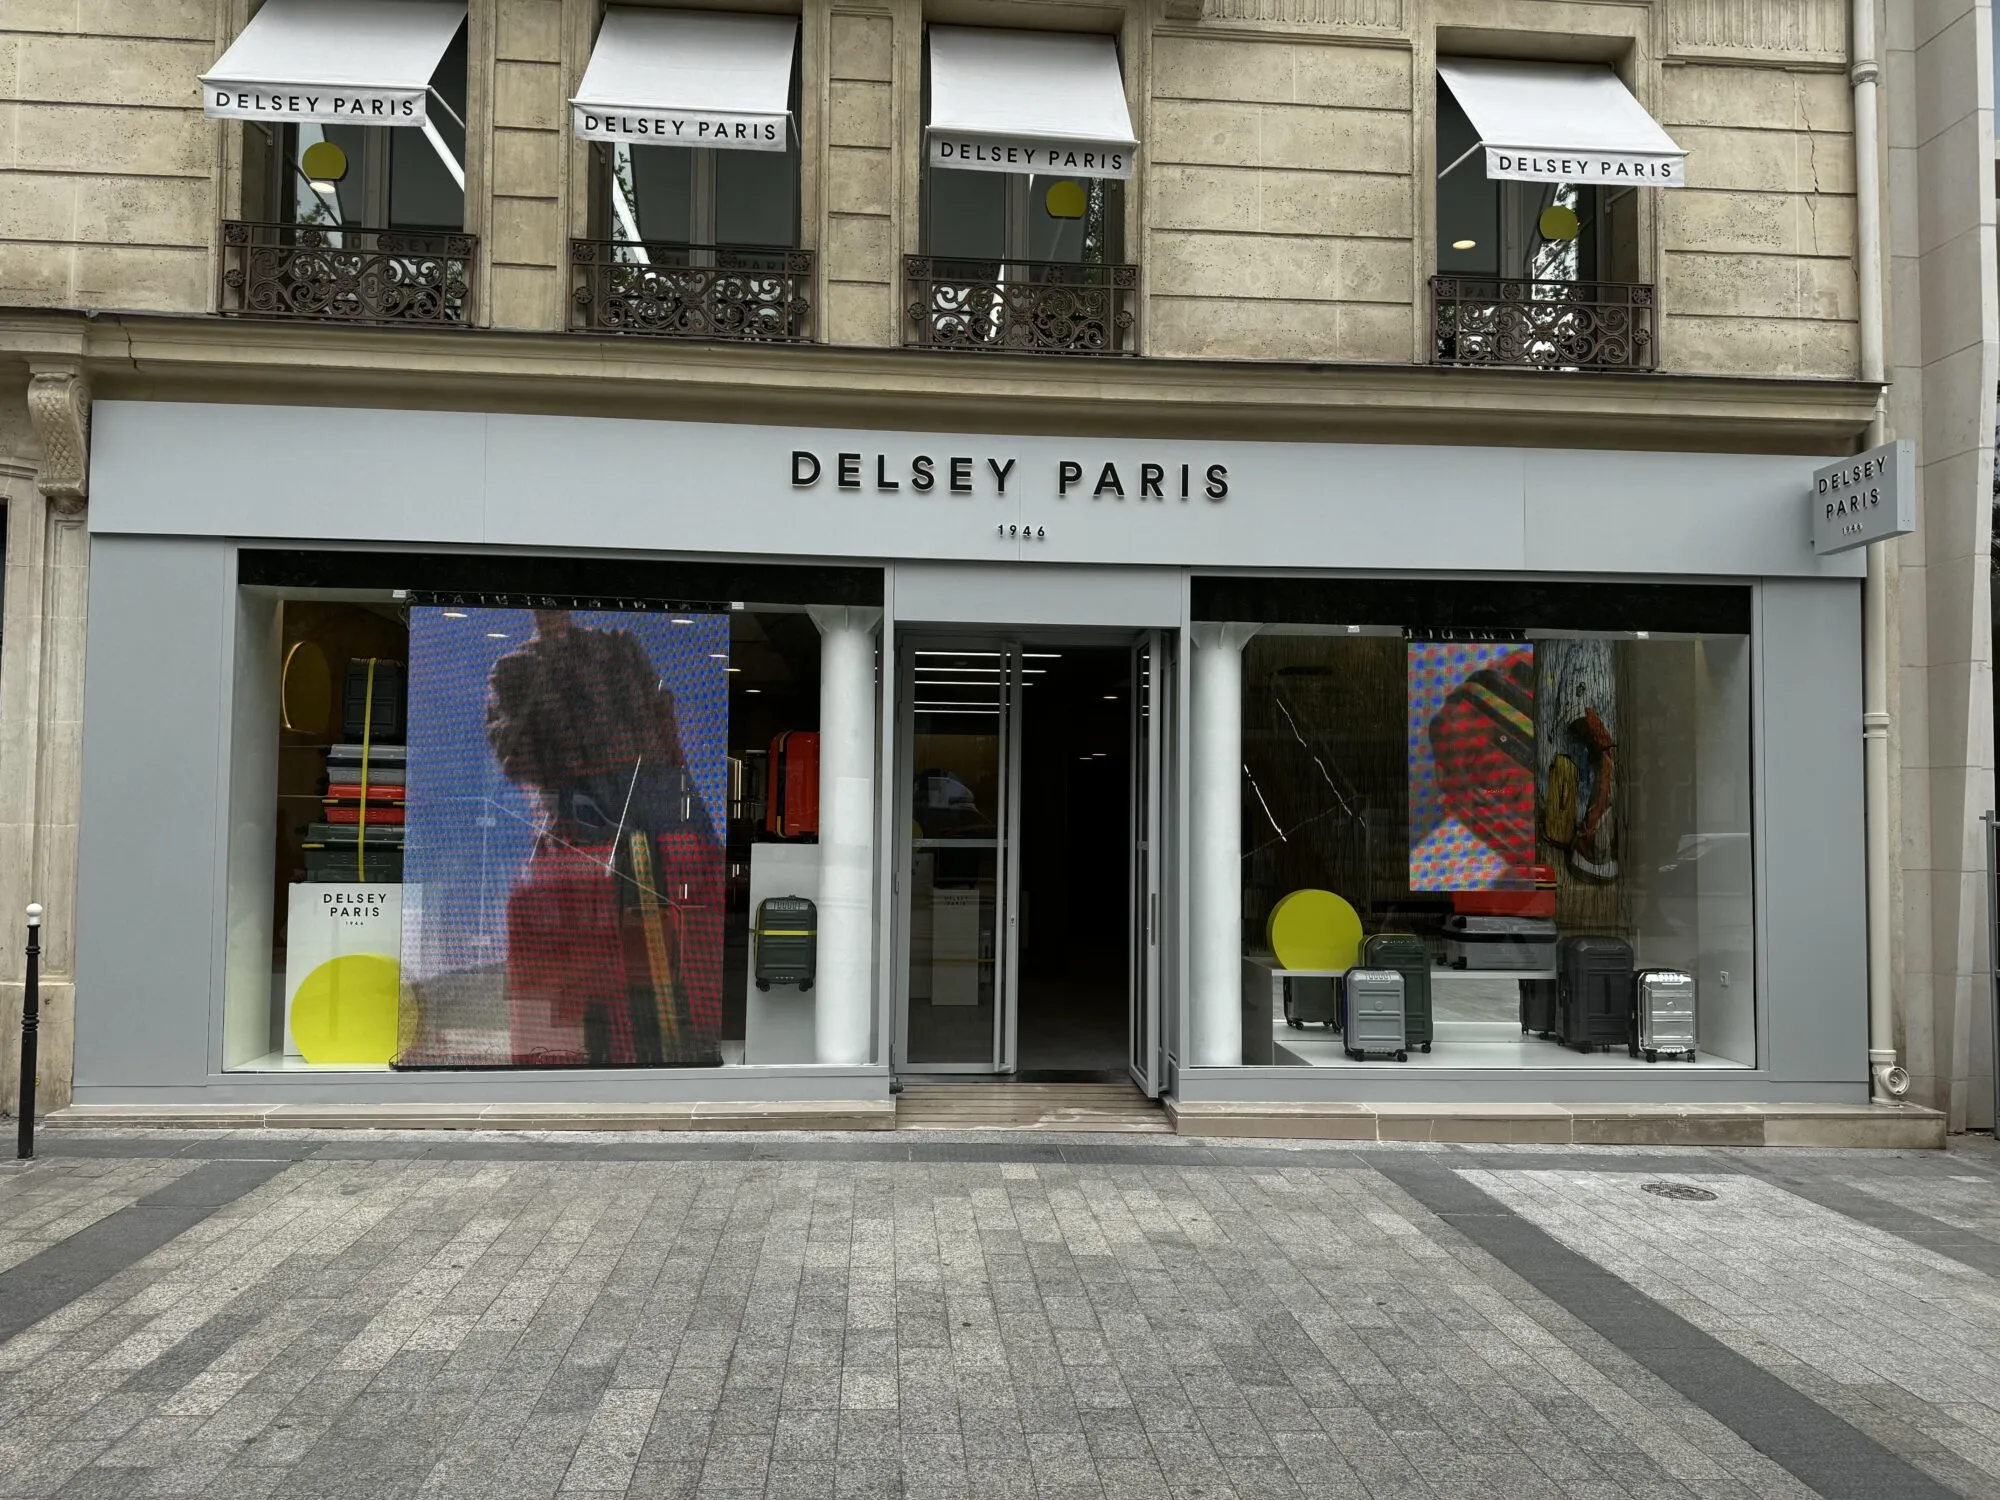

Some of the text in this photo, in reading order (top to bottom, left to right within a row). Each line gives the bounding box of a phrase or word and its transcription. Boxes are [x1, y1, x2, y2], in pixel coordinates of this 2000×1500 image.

[216, 92, 414, 116] DELSEY PARIS
[585, 116, 775, 140] DELSEY PARIS
[941, 142, 1122, 170] DELSEY PARIS
[1500, 156, 1671, 177] DELSEY PARIS
[792, 451, 1229, 499] DELSEY PARIS
[1819, 456, 1886, 494] DELSEY
[1826, 488, 1880, 519] PARIS
[998, 524, 1045, 538] 1946
[1842, 523, 1862, 535] 1946
[323, 893, 387, 903] DELSEY
[330, 907, 380, 917] PARIS
